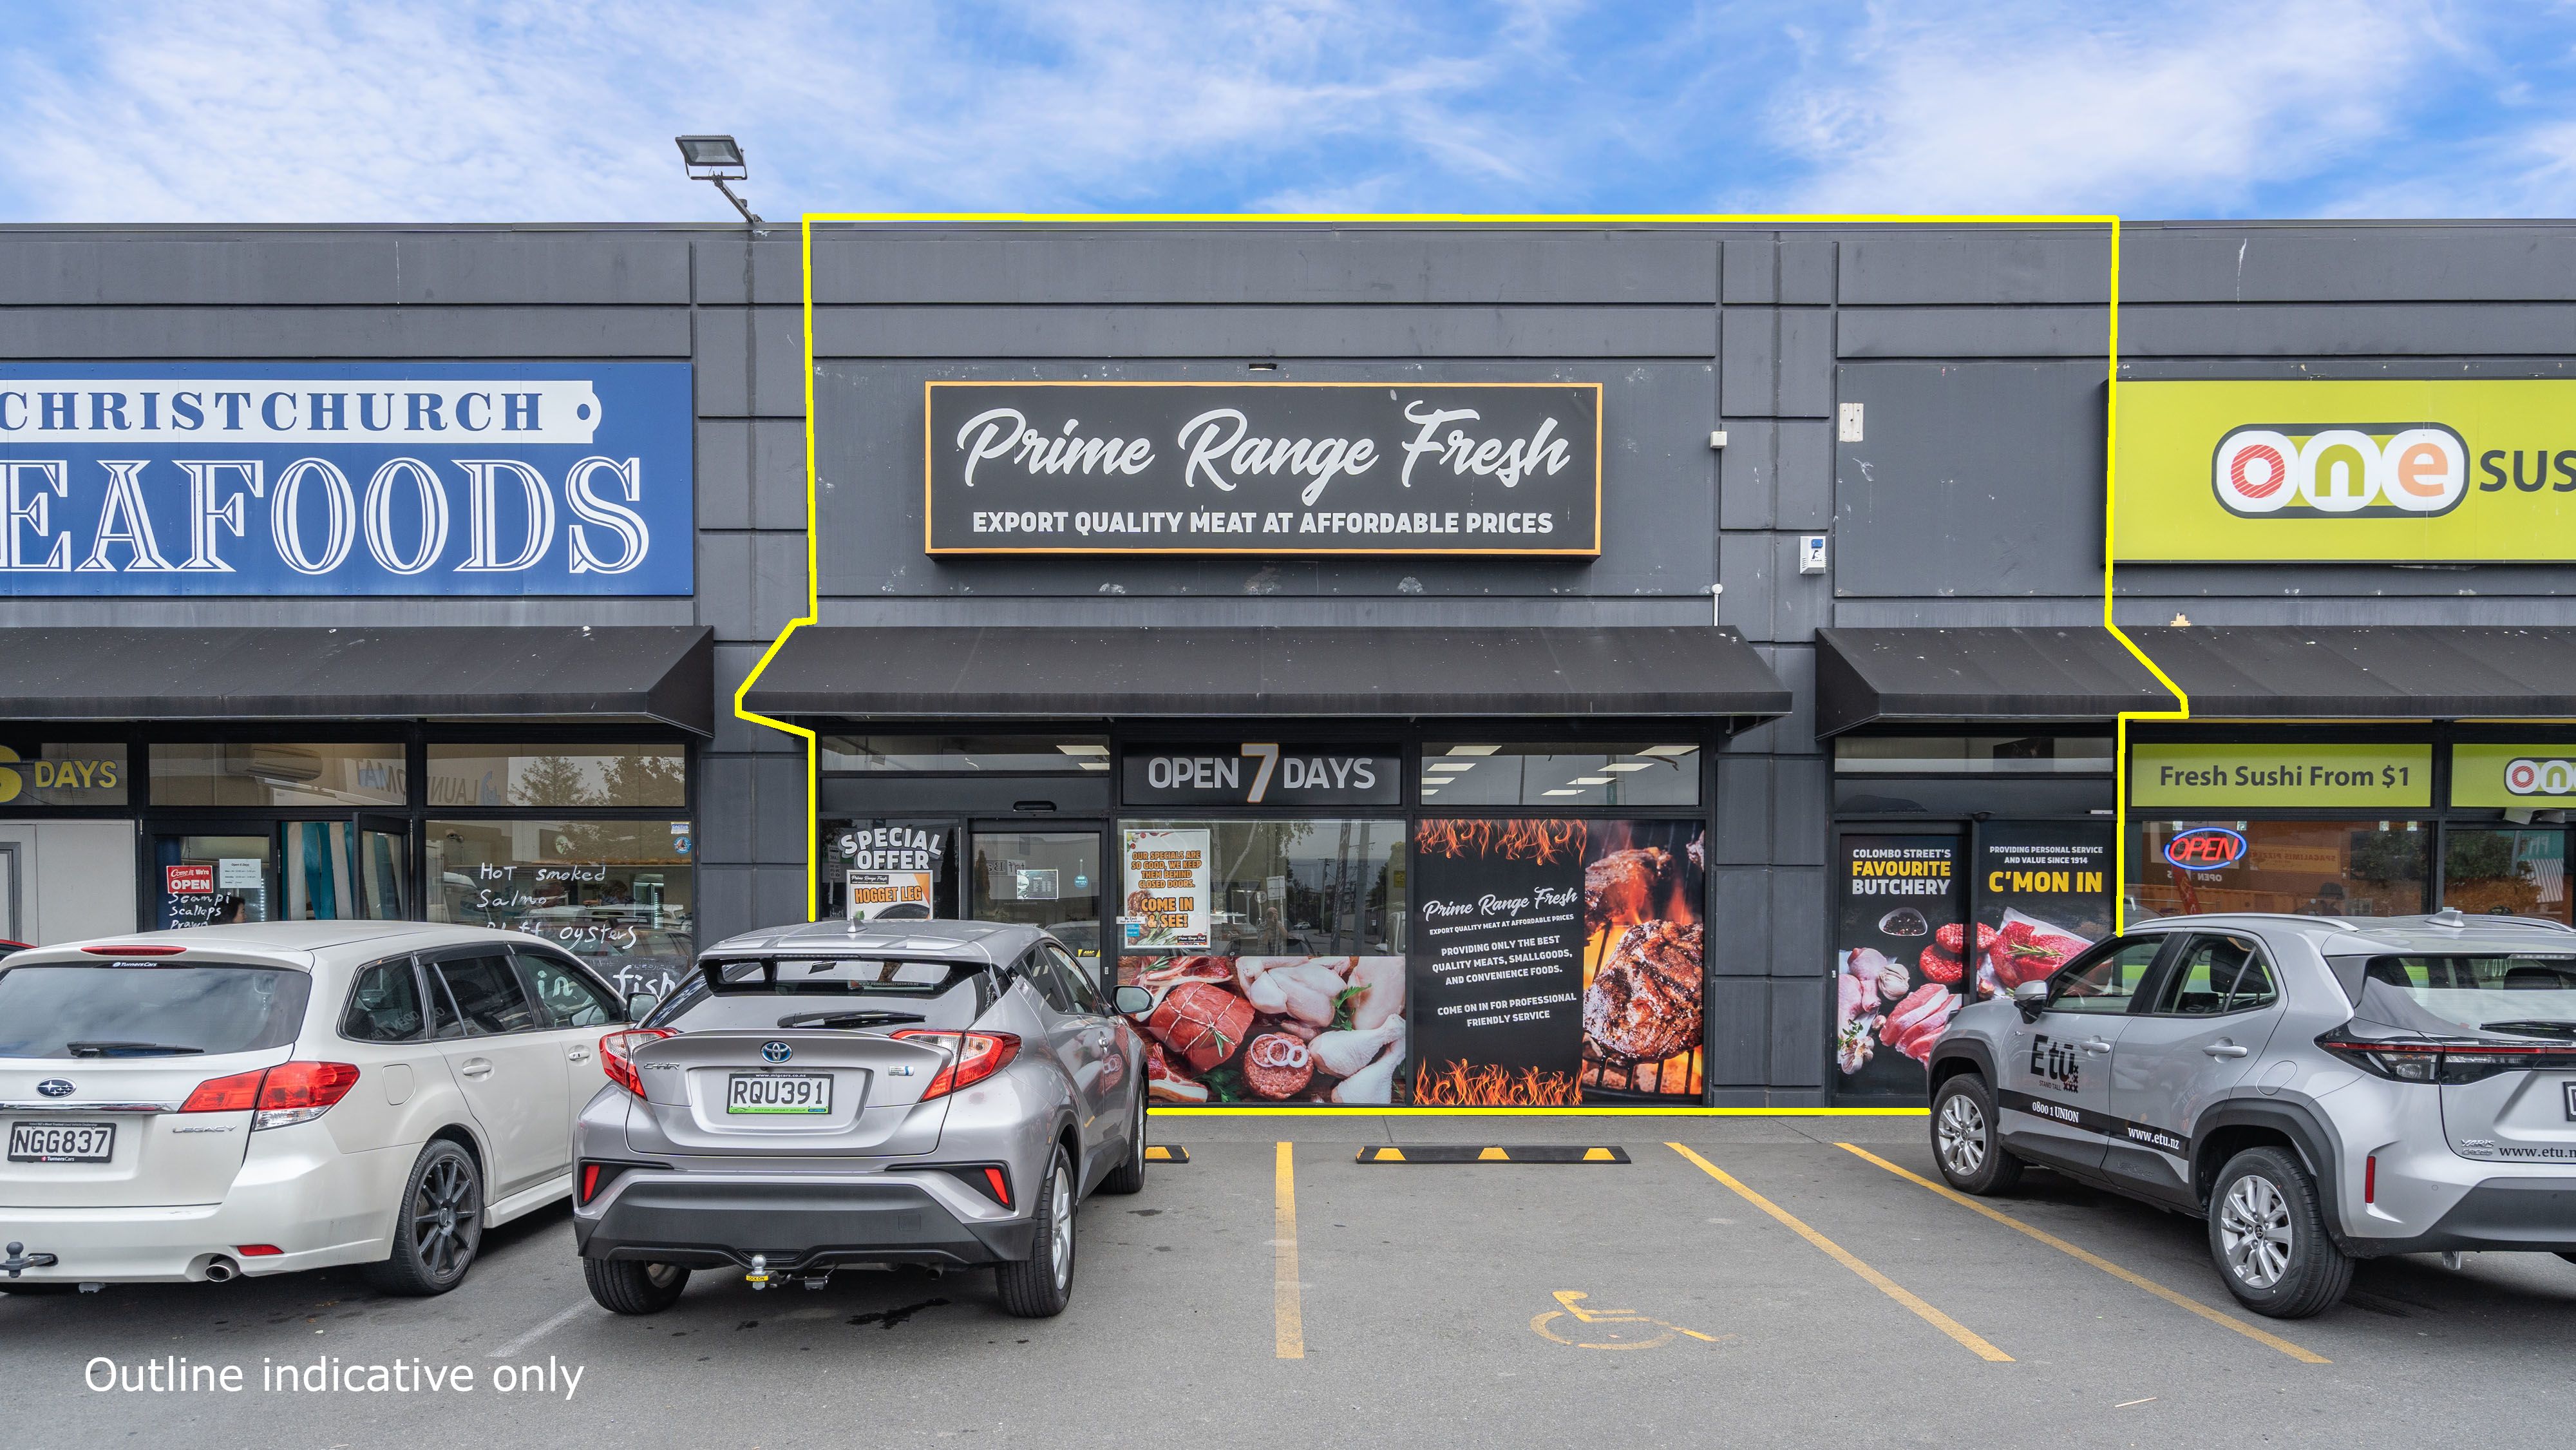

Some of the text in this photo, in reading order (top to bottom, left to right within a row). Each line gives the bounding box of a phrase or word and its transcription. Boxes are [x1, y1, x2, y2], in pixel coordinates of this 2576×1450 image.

[0, 392, 543, 432] CHRISTCHURCH
[957, 400, 1571, 506] Prime Range Fresh
[2230, 443, 2448, 499] one
[973, 511, 1553, 534] EXPORT QUALITY MEAT AT AFFORDABLE PRICES
[35, 760, 117, 788] DAYS
[1148, 743, 1376, 803] OPEN 7 DAYS
[2160, 765, 2409, 788] Fresh Sushi From $1
[840, 827, 942, 857] SPECIAL
[2169, 837, 2240, 861] OPEN
[857, 850, 929, 870] OFFER
[1132, 850, 1201, 860] OUR SPECIALS ARE
[1853, 849, 1951, 858] COLOMBO STREET'S
[171, 869, 189, 877] Come
[535, 864, 605, 881] smoked
[1132, 860, 1202, 870] SO GOOD, WE KEEP
[1141, 870, 1192, 879] THEM BEHIND
[1852, 861, 1951, 877] FAVOURITE
[171, 879, 210, 890] OPEN
[1138, 879, 1196, 888] CLOSED DOORS.
[1852, 879, 1951, 895] BUTCHERY
[1989, 871, 2103, 893] C'MON IN
[855, 886, 923, 904] HOGGET LEG
[1141, 897, 1194, 912] COME IN
[1423, 886, 1578, 922] Prime Range Fresh
[169, 904, 222, 921] Scallops
[1147, 913, 1189, 928] & SEE!
[1429, 927, 1454, 935] EXPORT
[1454, 924, 1482, 933] QUALITY
[1511, 916, 1551, 926] AFFORDABLE
[1552, 913, 1574, 922] PRICES
[559, 923, 637, 951] oysters
[1441, 935, 1560, 956] PROVIDING ONLY THE BEST
[1432, 949, 1573, 973] QUALITY MEATS, SMALLGOODS,
[1445, 965, 1563, 986] AND CONVENIENCE FOODS.
[1437, 993, 1577, 1016] COME ON IN FOR PROFESSIONAL
[1466, 1010, 1550, 1027] FRIENDLY SERVICE
[734, 1081, 822, 1105] RQU391
[2039, 1080, 2052, 1089] STAND
[2032, 1101, 2079, 1123] 0800 1 UNION
[173, 1125, 237, 1133] LEGACY
[2128, 1127, 2179, 1150] www.etu.nz
[15, 1130, 108, 1153] NGG837
